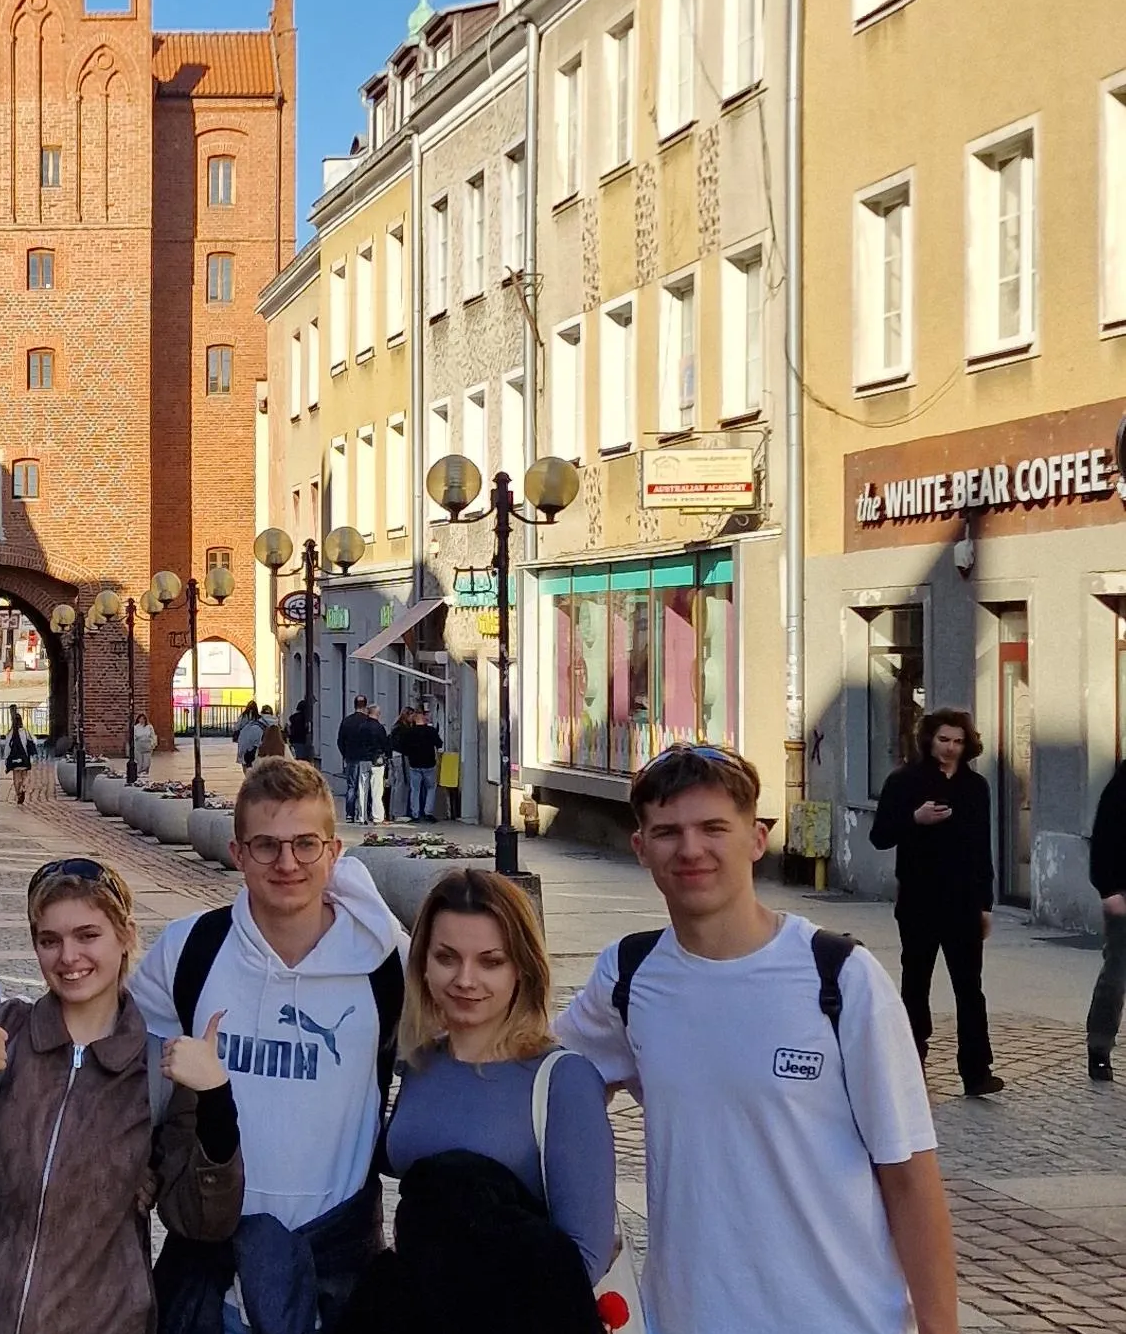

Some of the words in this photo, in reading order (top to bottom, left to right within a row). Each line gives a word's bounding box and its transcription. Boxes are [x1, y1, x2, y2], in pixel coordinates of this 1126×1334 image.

[653, 484, 705, 493] AUSTRALIAN
[706, 483, 746, 492] ACADEMY
[856, 483, 882, 523] the
[884, 474, 948, 518] WHITE
[951, 464, 1011, 510] BEAR
[1014, 448, 1108, 502] COFFEE
[779, 1060, 816, 1078] Jeep
